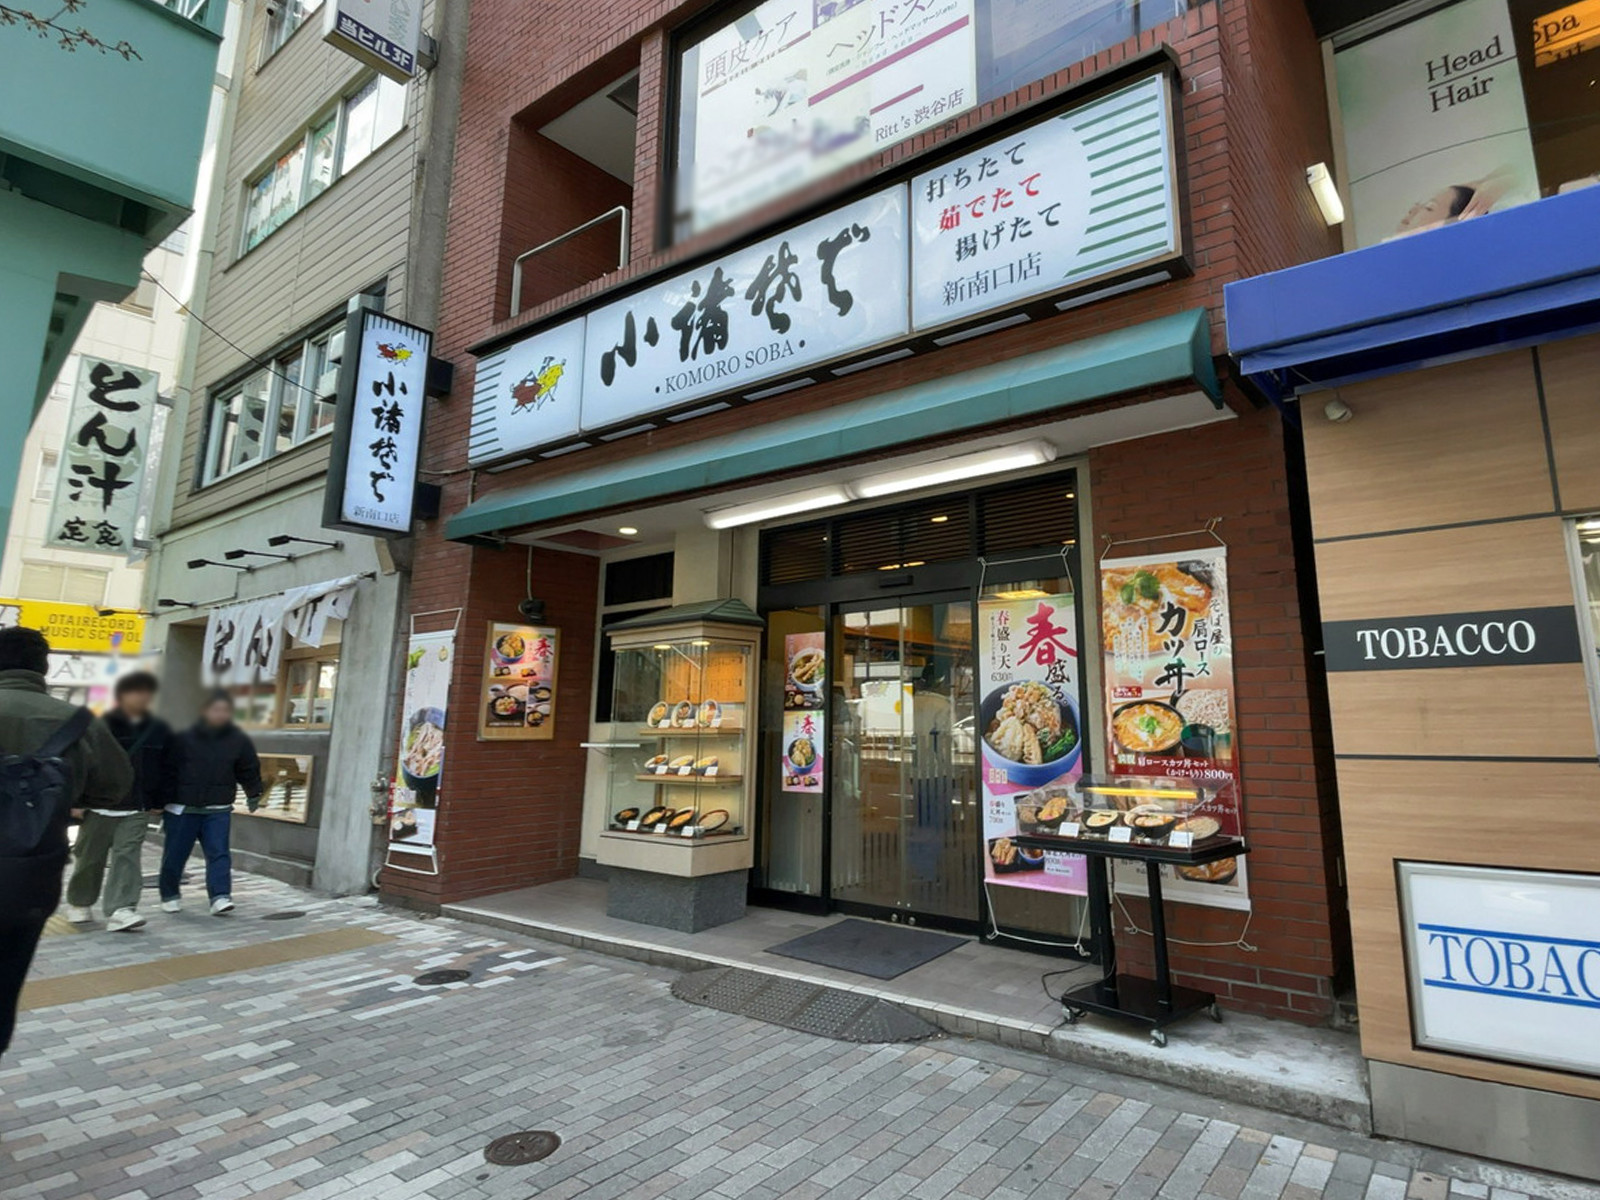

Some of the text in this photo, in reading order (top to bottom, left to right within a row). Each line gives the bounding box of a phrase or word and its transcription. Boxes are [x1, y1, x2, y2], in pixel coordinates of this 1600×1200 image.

[340, 17, 411, 67] 当ビル3F
[703, 11, 798, 85] 頭皮ケア
[826, 0, 937, 58] ヘッドス
[1425, 35, 1503, 83] Head
[913, 89, 965, 126] 渋谷店
[1430, 76, 1494, 113] Hair
[926, 142, 1027, 203] 打ちたて
[939, 173, 1042, 232] 茹でたて
[955, 203, 1062, 263] 揚げたて
[942, 251, 1042, 307] 新南口店
[665, 339, 795, 394] KOMORO SOBA
[67, 362, 142, 514] とん汁
[58, 516, 124, 547] 定食
[88, 628, 141, 643] SCHOL
[995, 610, 1011, 669] 春盛り天
[1154, 601, 1195, 695] カツ丼
[1191, 619, 1210, 676] 肩ロース
[1356, 620, 1536, 660] TOBACCO
